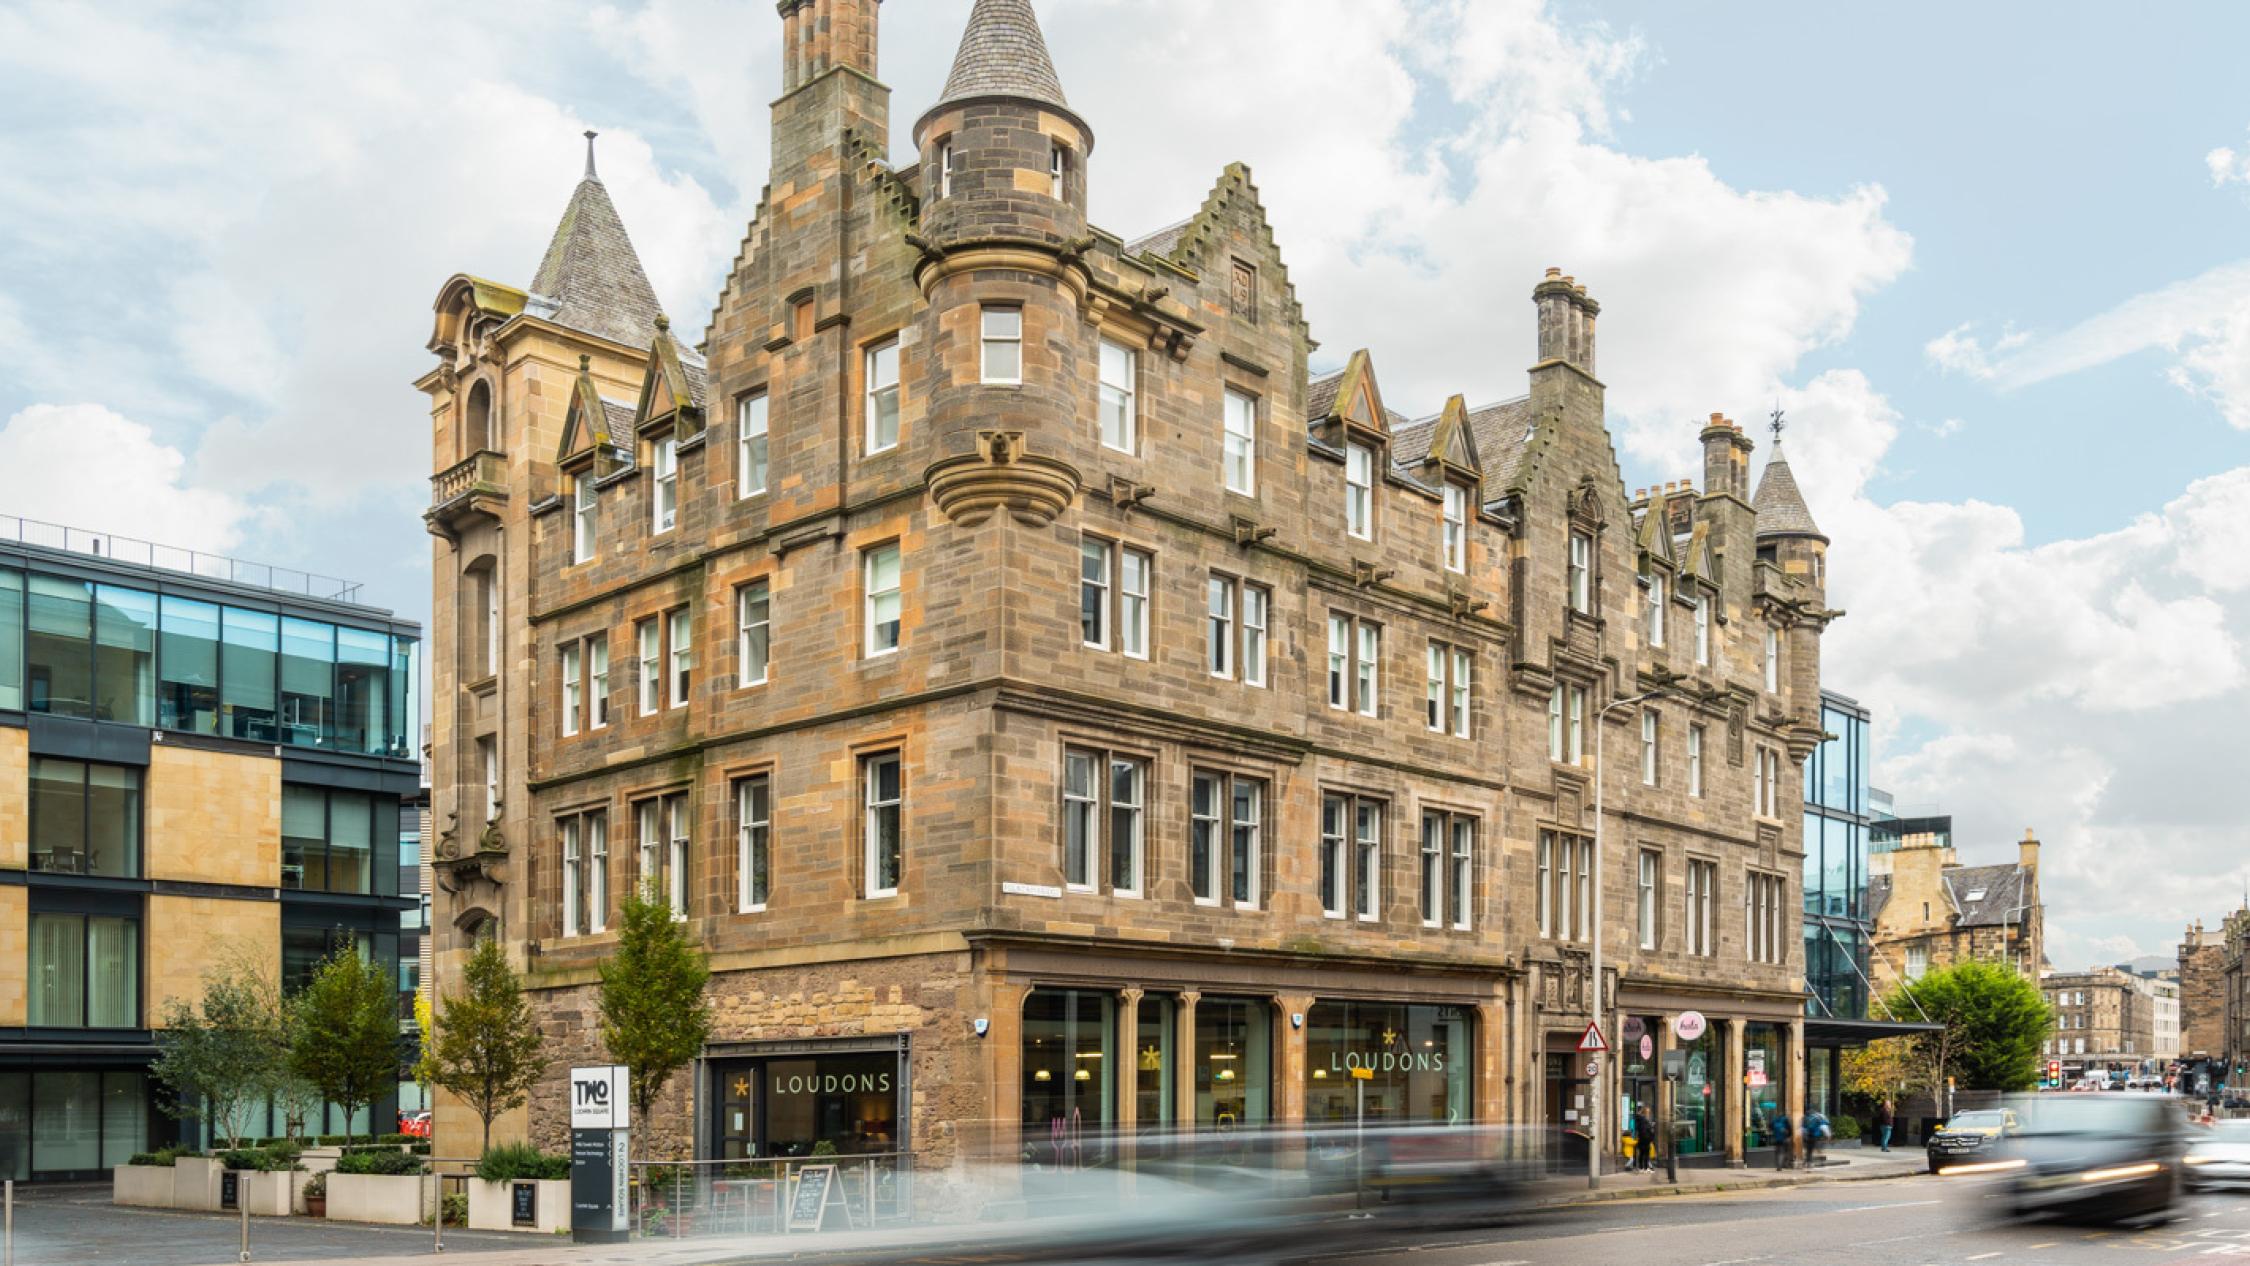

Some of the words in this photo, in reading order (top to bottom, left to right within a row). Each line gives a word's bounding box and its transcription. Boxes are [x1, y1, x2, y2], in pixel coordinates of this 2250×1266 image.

[1331, 1051, 1443, 1072] LOUDONS
[574, 1080, 608, 1105] TWO
[776, 1073, 890, 1094] LOUDONS
[618, 1142, 625, 1153] 2
